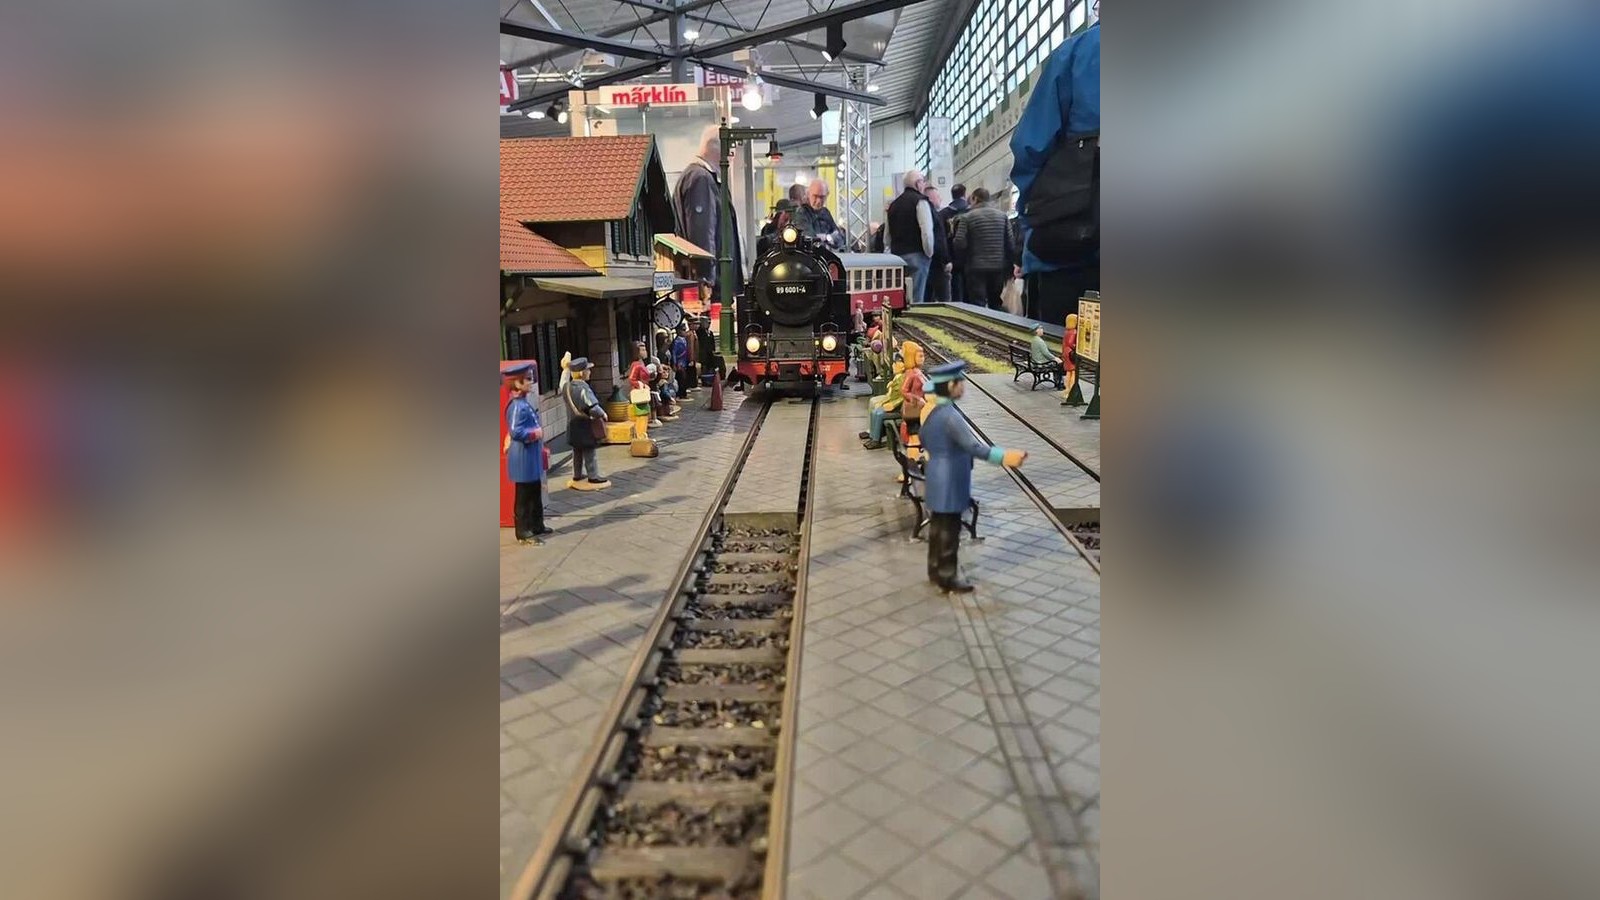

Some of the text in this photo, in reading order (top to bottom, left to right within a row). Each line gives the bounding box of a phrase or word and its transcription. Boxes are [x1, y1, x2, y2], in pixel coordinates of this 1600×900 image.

[612, 86, 686, 105] märklin
[776, 285, 806, 294] 99 6001-4
